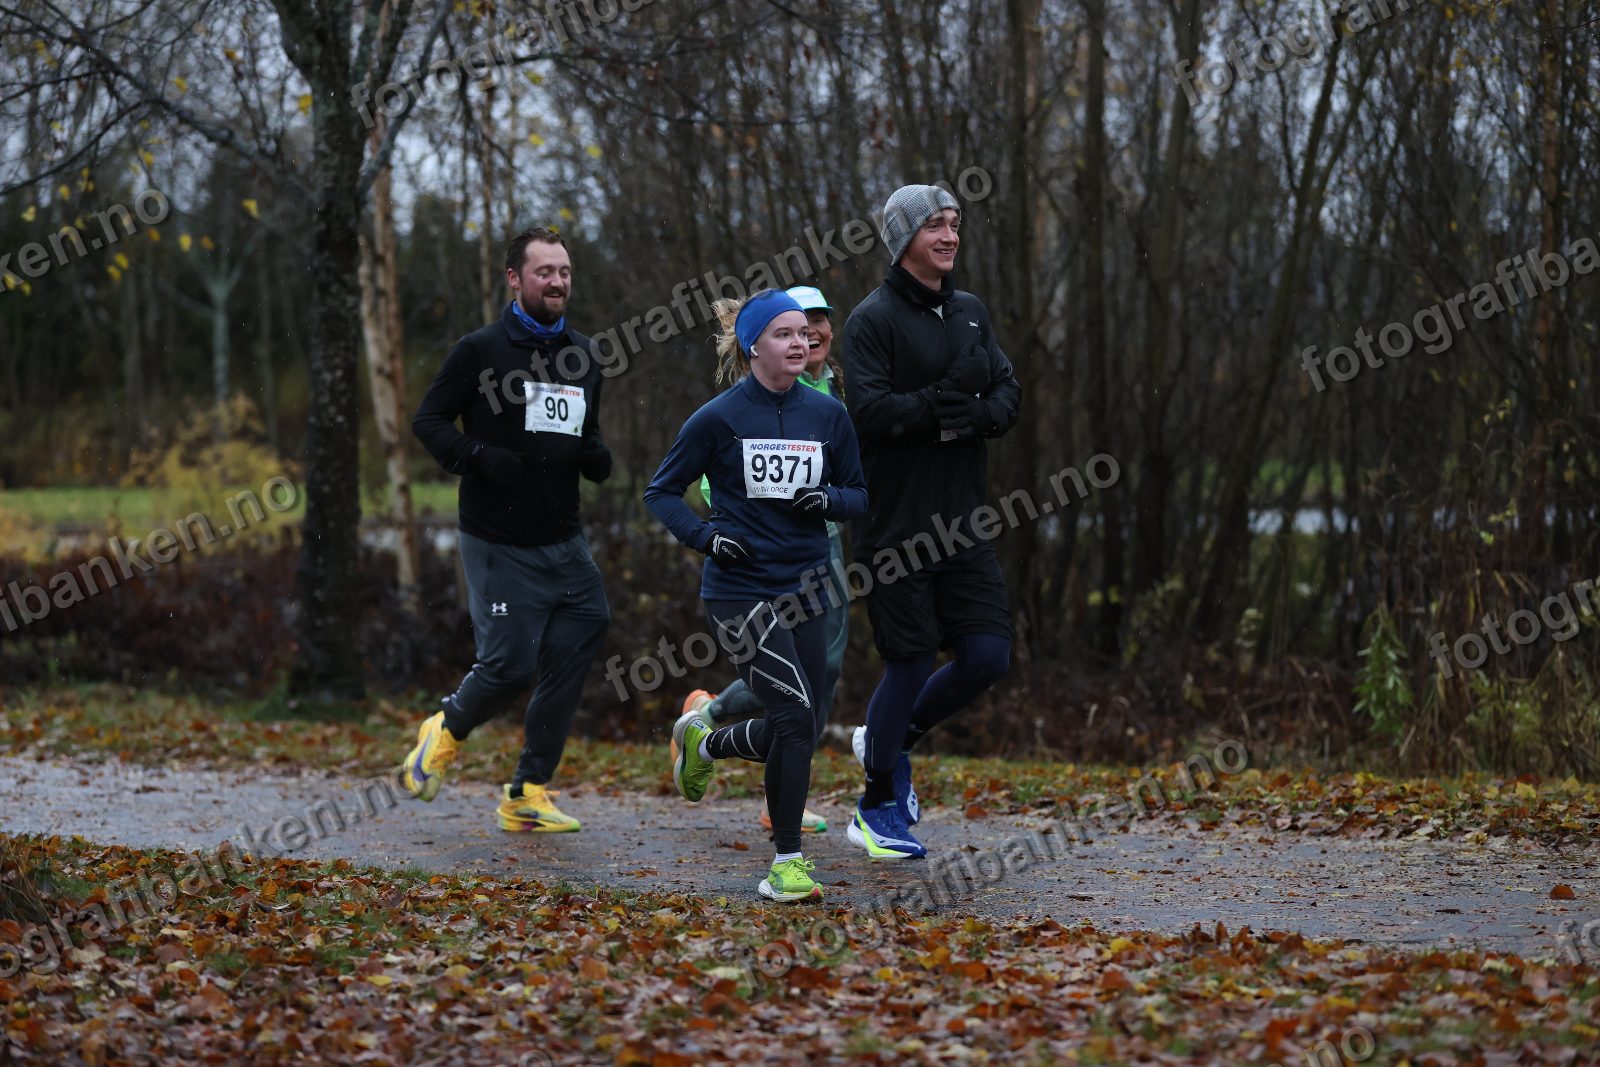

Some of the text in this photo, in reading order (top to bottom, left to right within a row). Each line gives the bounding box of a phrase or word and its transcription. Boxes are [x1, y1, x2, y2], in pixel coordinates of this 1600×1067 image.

[544, 396, 569, 422] 90
[750, 443, 817, 453] NORGESTESTEN
[751, 453, 812, 485] 9371
